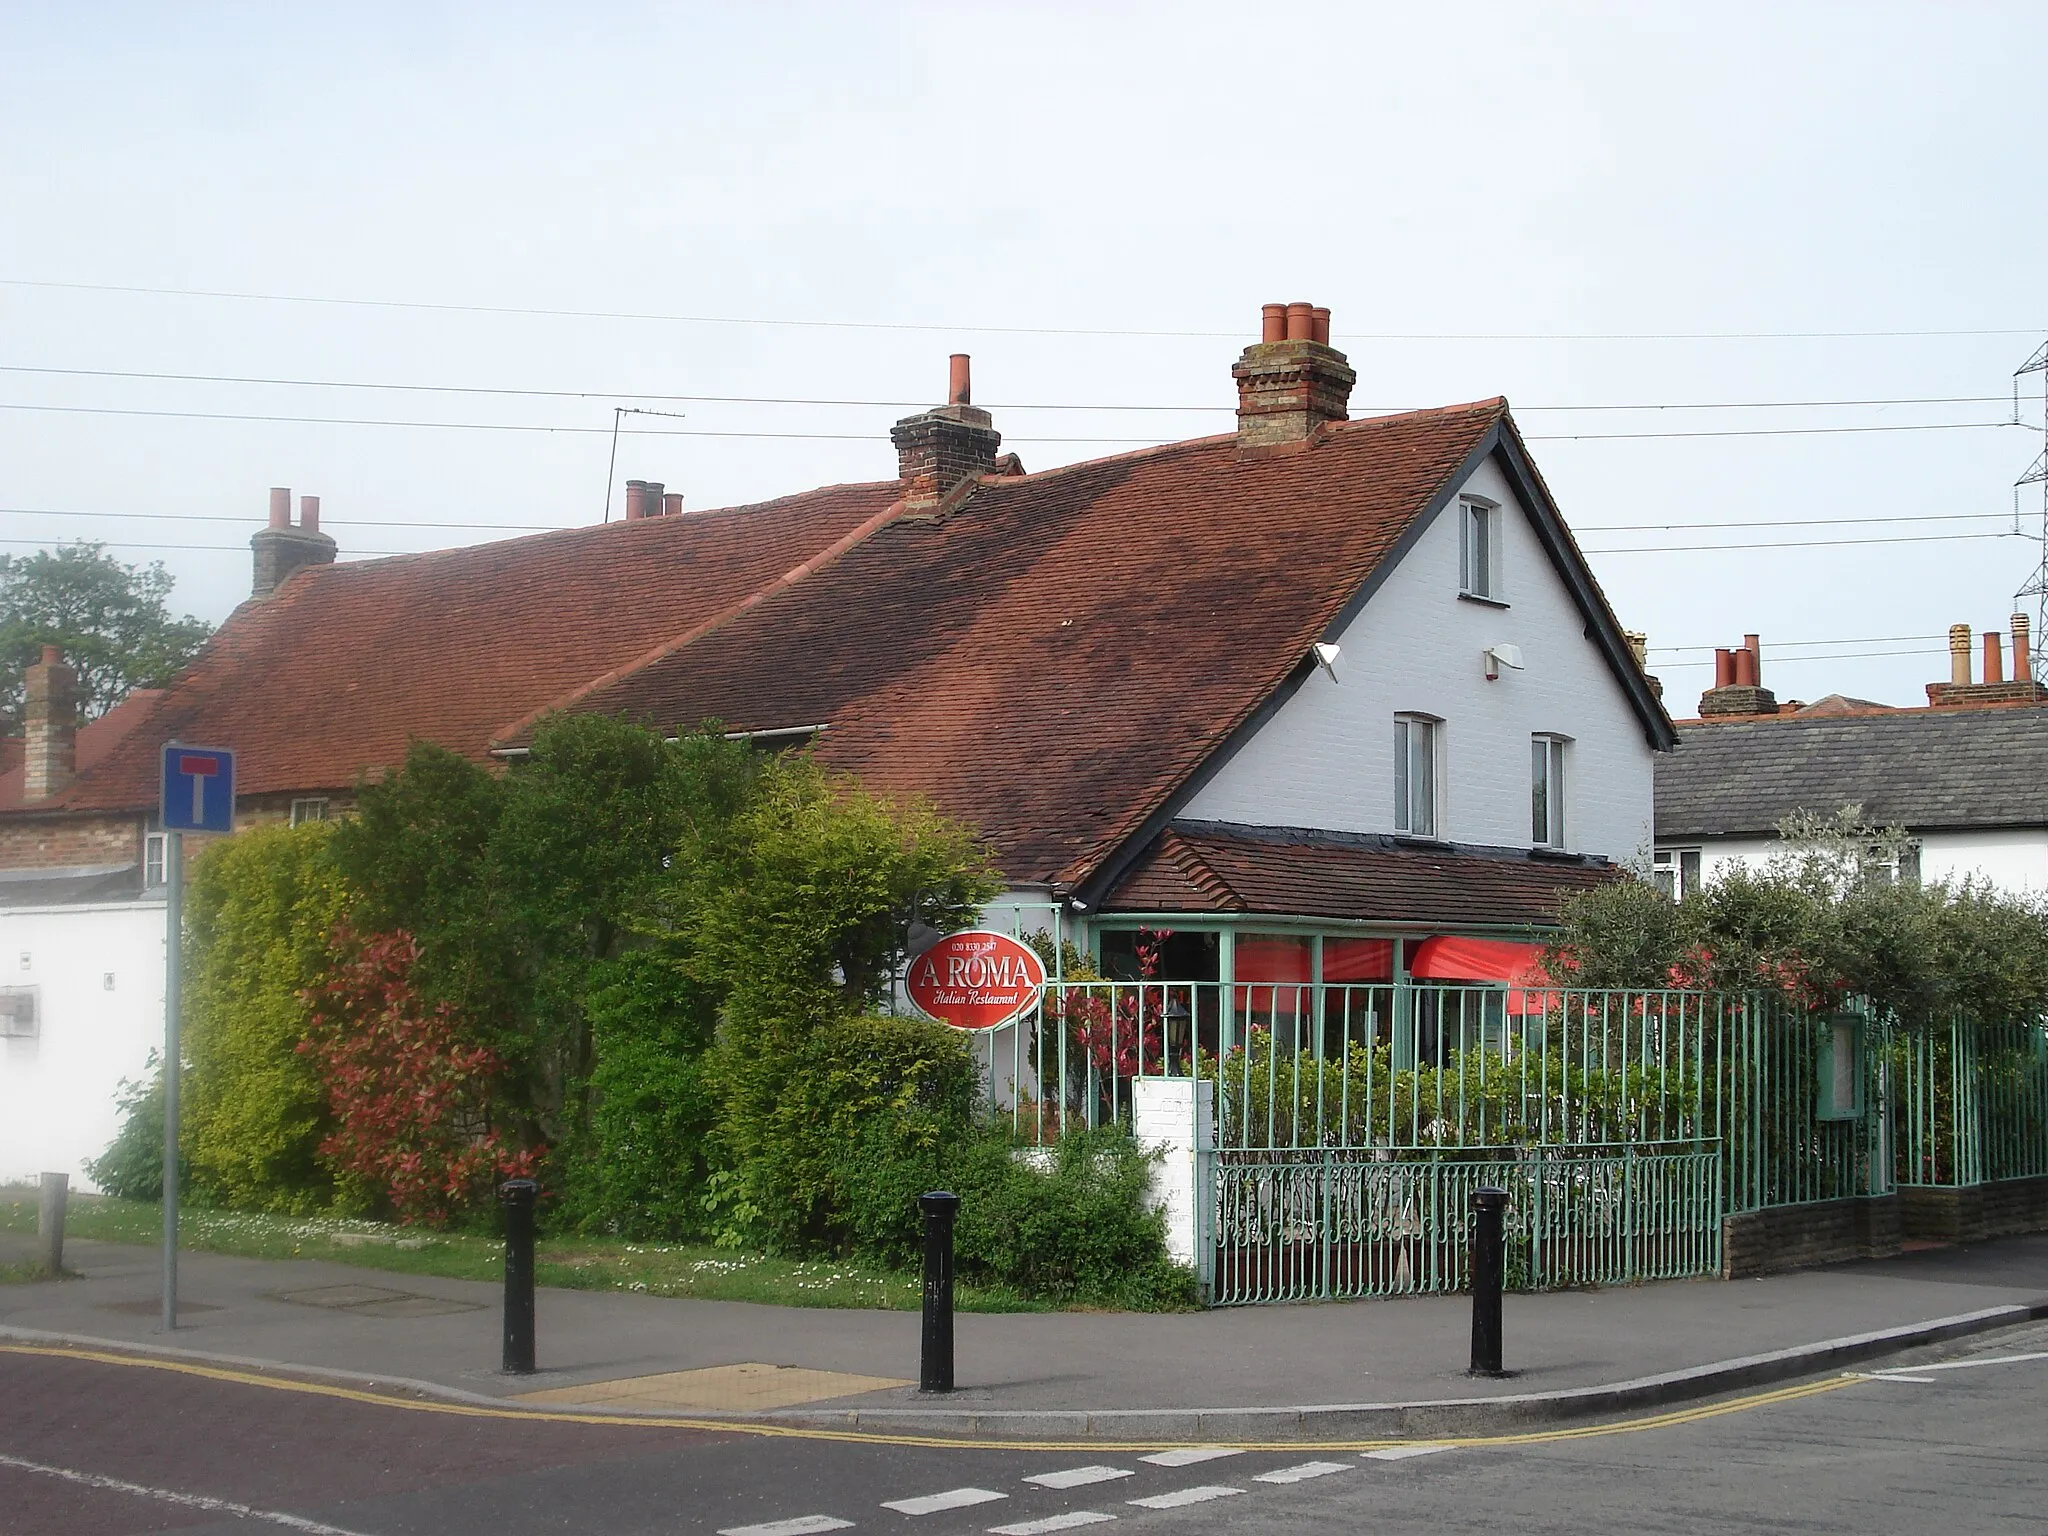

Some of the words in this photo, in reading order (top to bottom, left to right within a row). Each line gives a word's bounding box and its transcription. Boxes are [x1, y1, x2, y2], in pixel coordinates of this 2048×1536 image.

[951, 942, 964, 951] 020
[920, 957, 941, 987] A
[947, 956, 1034, 988] ROMA
[933, 990, 966, 1005] Italian
[968, 989, 1018, 1005] Restaurant
